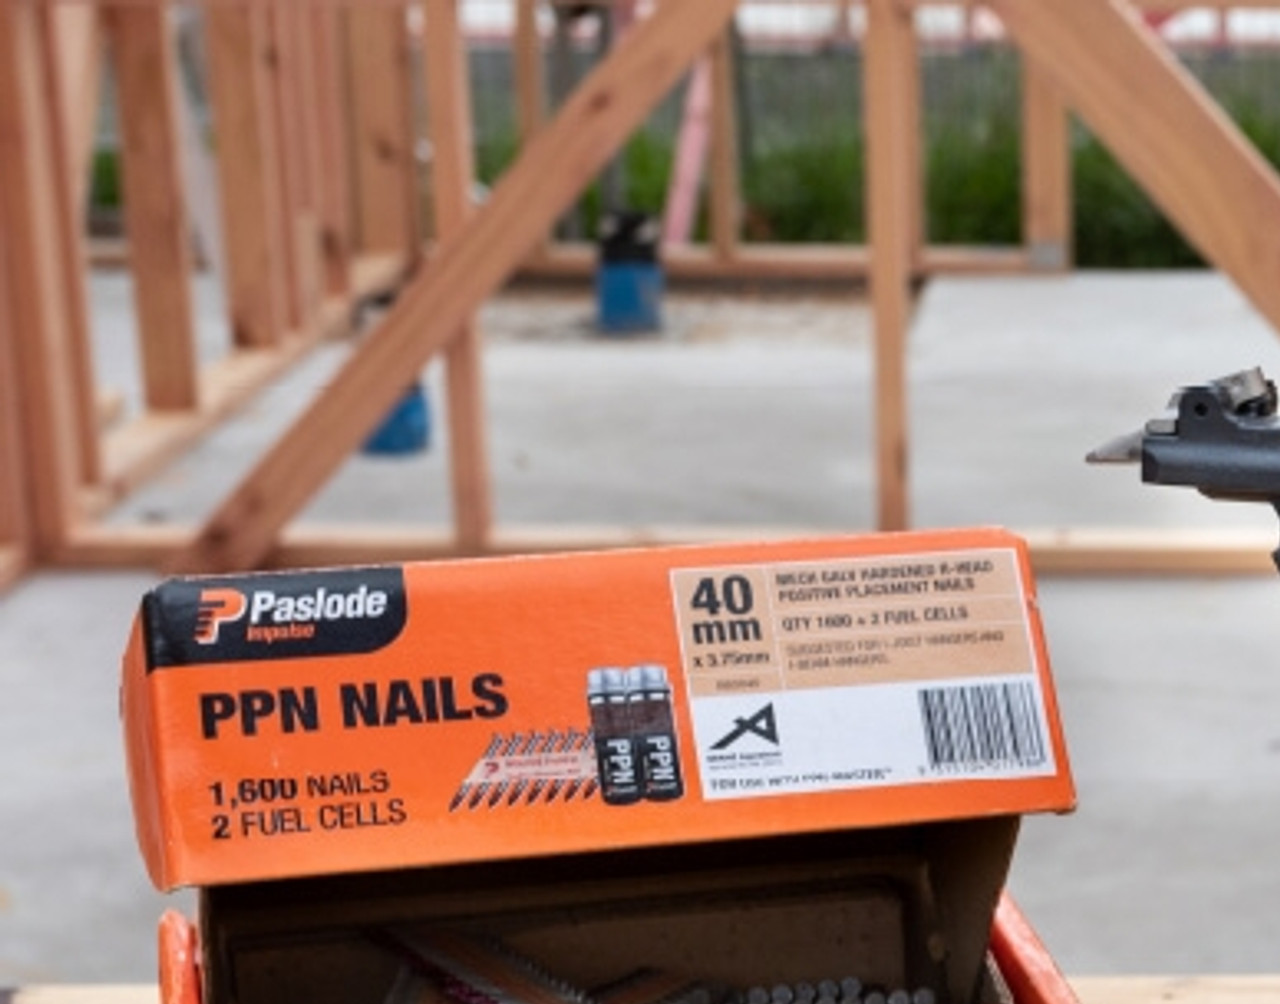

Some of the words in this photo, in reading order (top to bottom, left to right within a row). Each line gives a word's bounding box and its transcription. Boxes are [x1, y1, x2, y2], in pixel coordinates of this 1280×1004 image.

[251, 584, 388, 624] Paslode
[690, 573, 754, 617] 40
[692, 617, 762, 645] mm
[781, 616, 811, 633] QTY
[923, 605, 969, 621] CELLS
[199, 686, 320, 740] PPN
[339, 672, 509, 729] NAILS
[607, 738, 636, 784] PPN
[647, 735, 675, 780] PPN
[209, 777, 298, 809] 1,600
[306, 770, 390, 798] NAILS
[211, 814, 231, 840] 2
[241, 808, 312, 837] FUEL
[318, 799, 407, 830] CELLS
